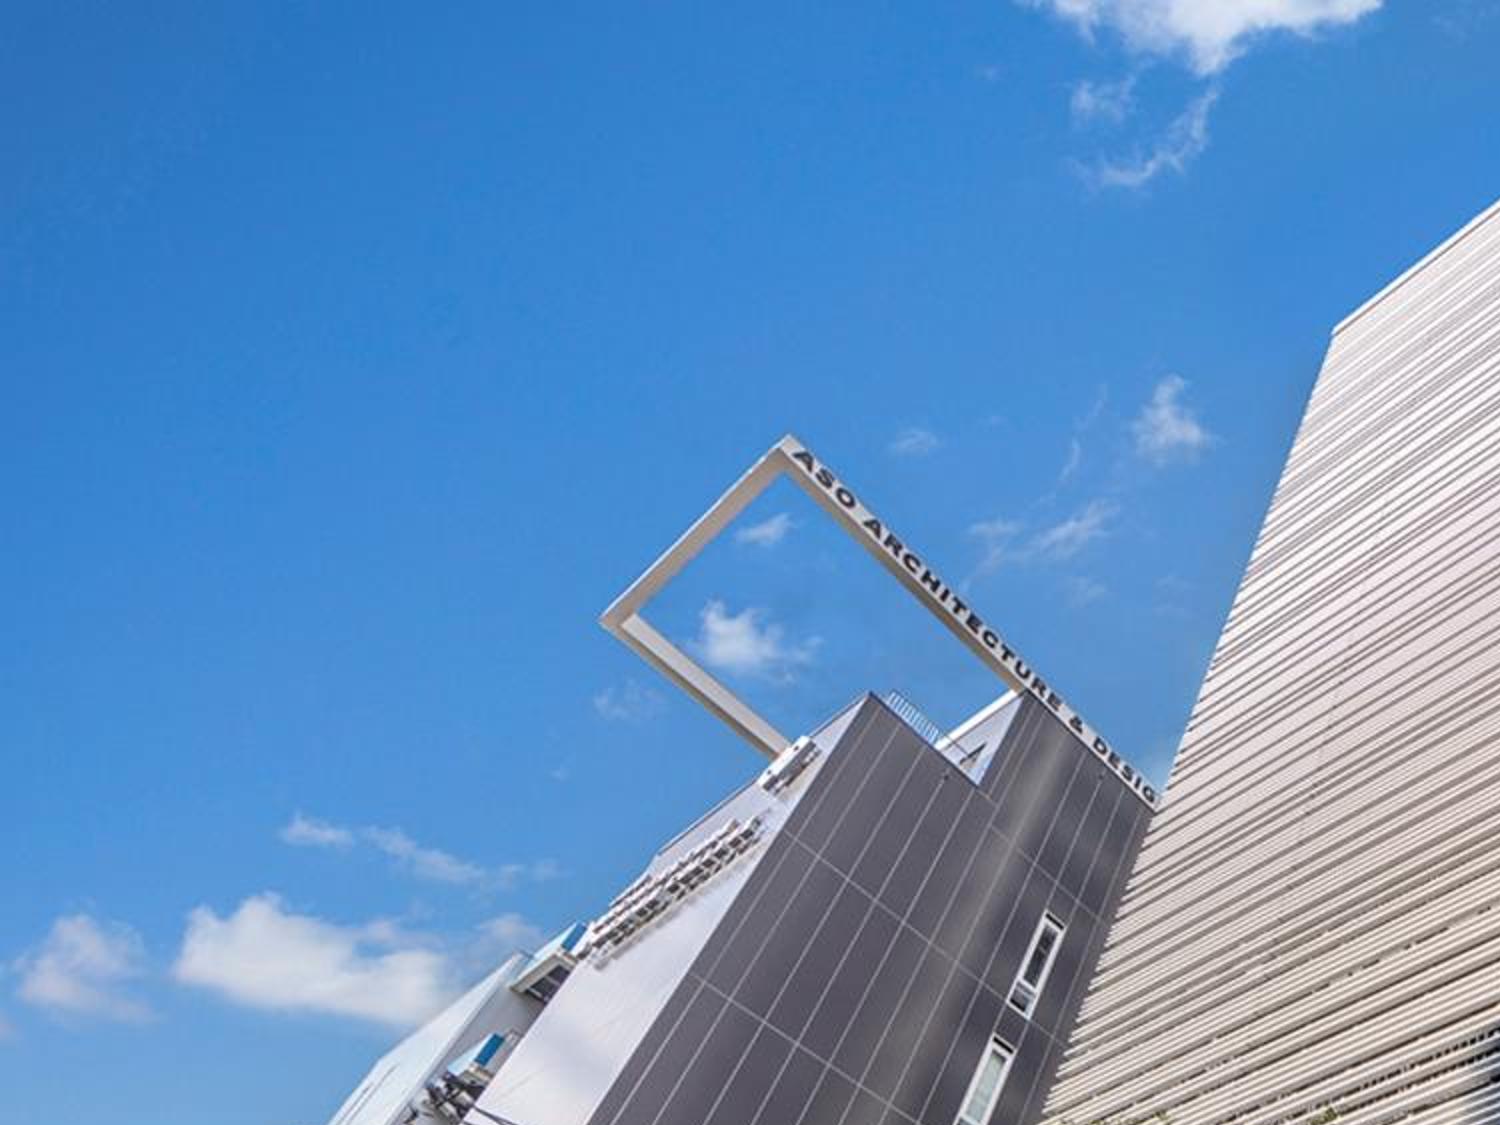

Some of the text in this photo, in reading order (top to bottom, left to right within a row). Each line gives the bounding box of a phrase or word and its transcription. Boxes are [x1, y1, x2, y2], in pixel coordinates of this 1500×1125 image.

[792, 450, 1157, 804] ASO ARCHITECTURE & DESIG
